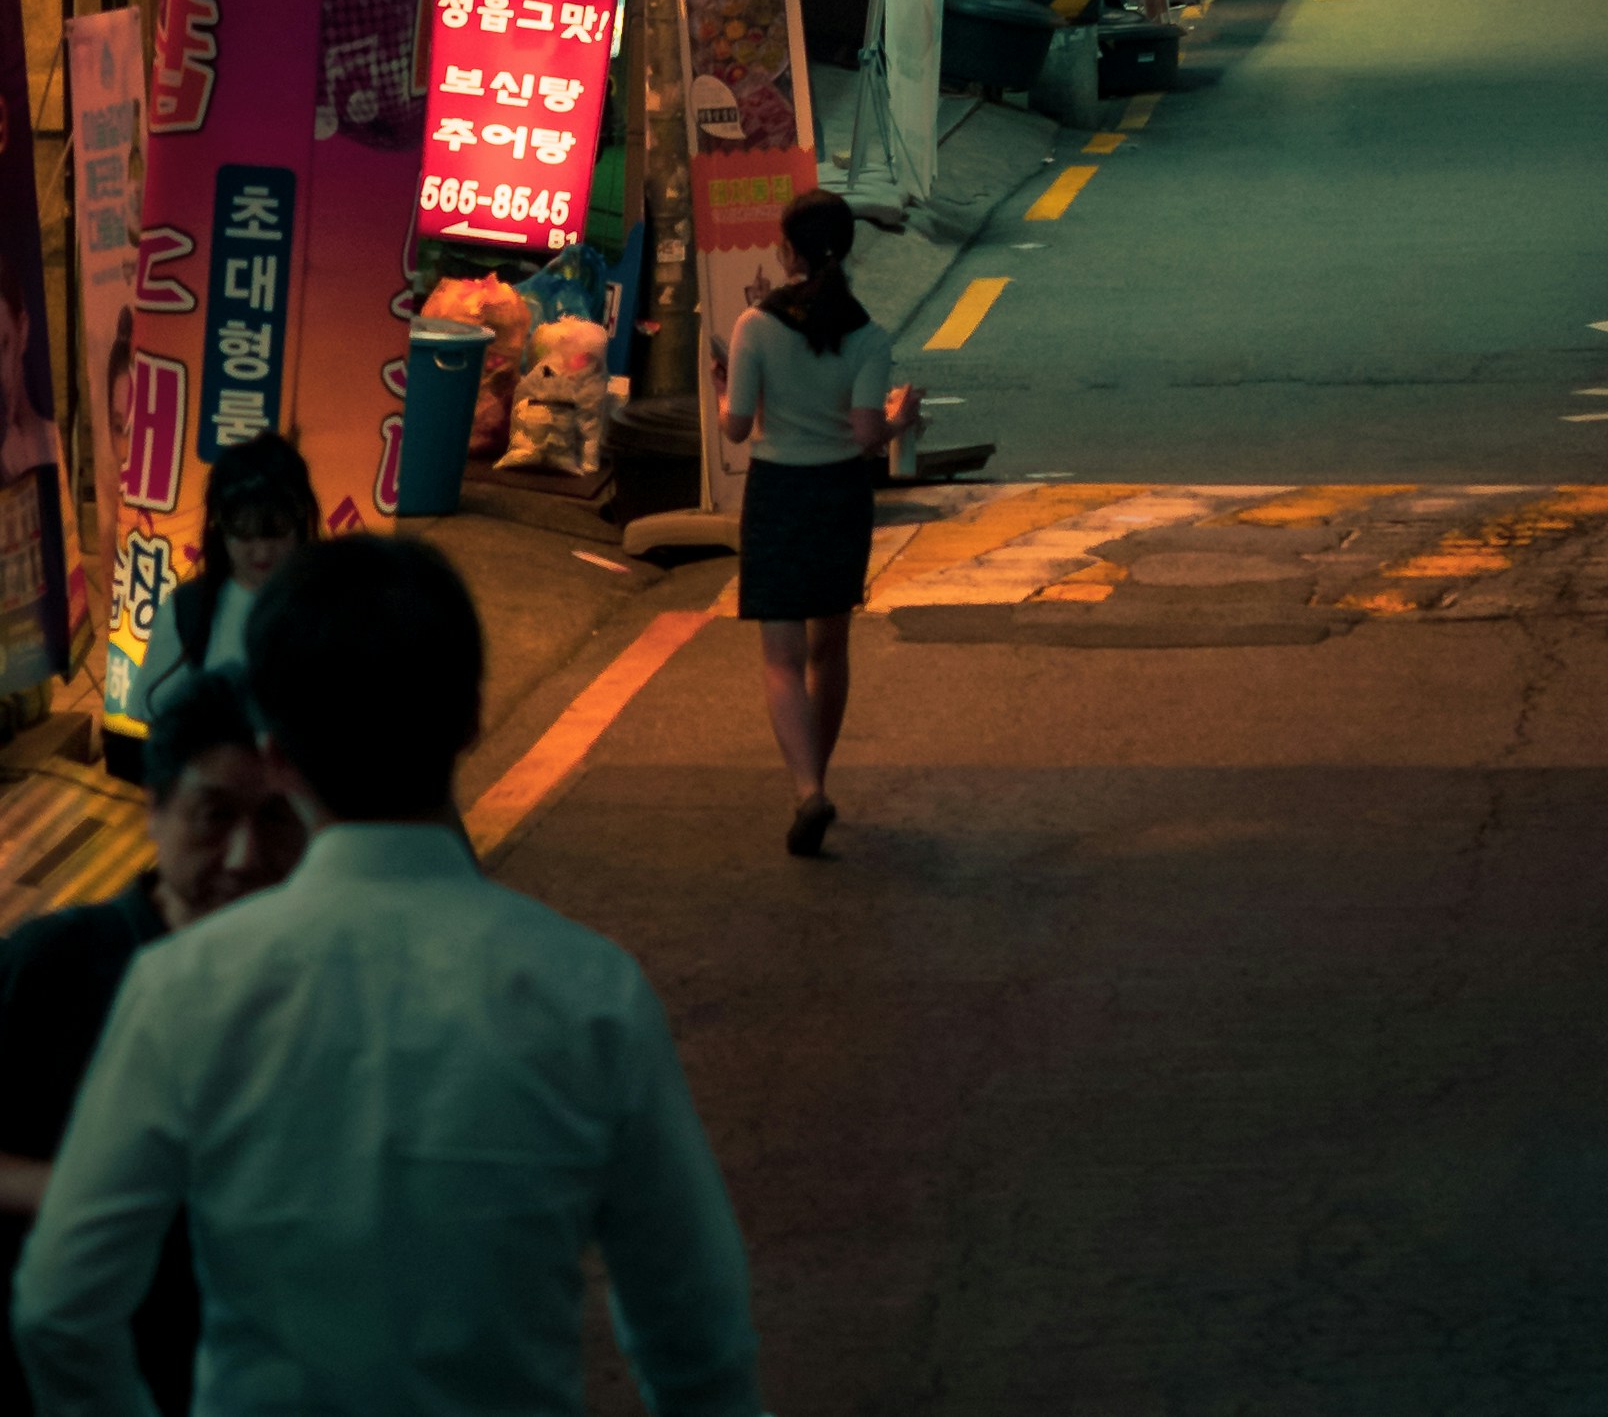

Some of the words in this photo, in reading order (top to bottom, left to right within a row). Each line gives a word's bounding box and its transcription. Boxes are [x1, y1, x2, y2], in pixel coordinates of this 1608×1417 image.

[439, 64, 585, 114] 보신탕
[432, 117, 577, 166] 추어탕
[420, 174, 572, 237] 565-8545
[547, 227, 579, 251] B1
[211, 185, 284, 446] 초대형룸
